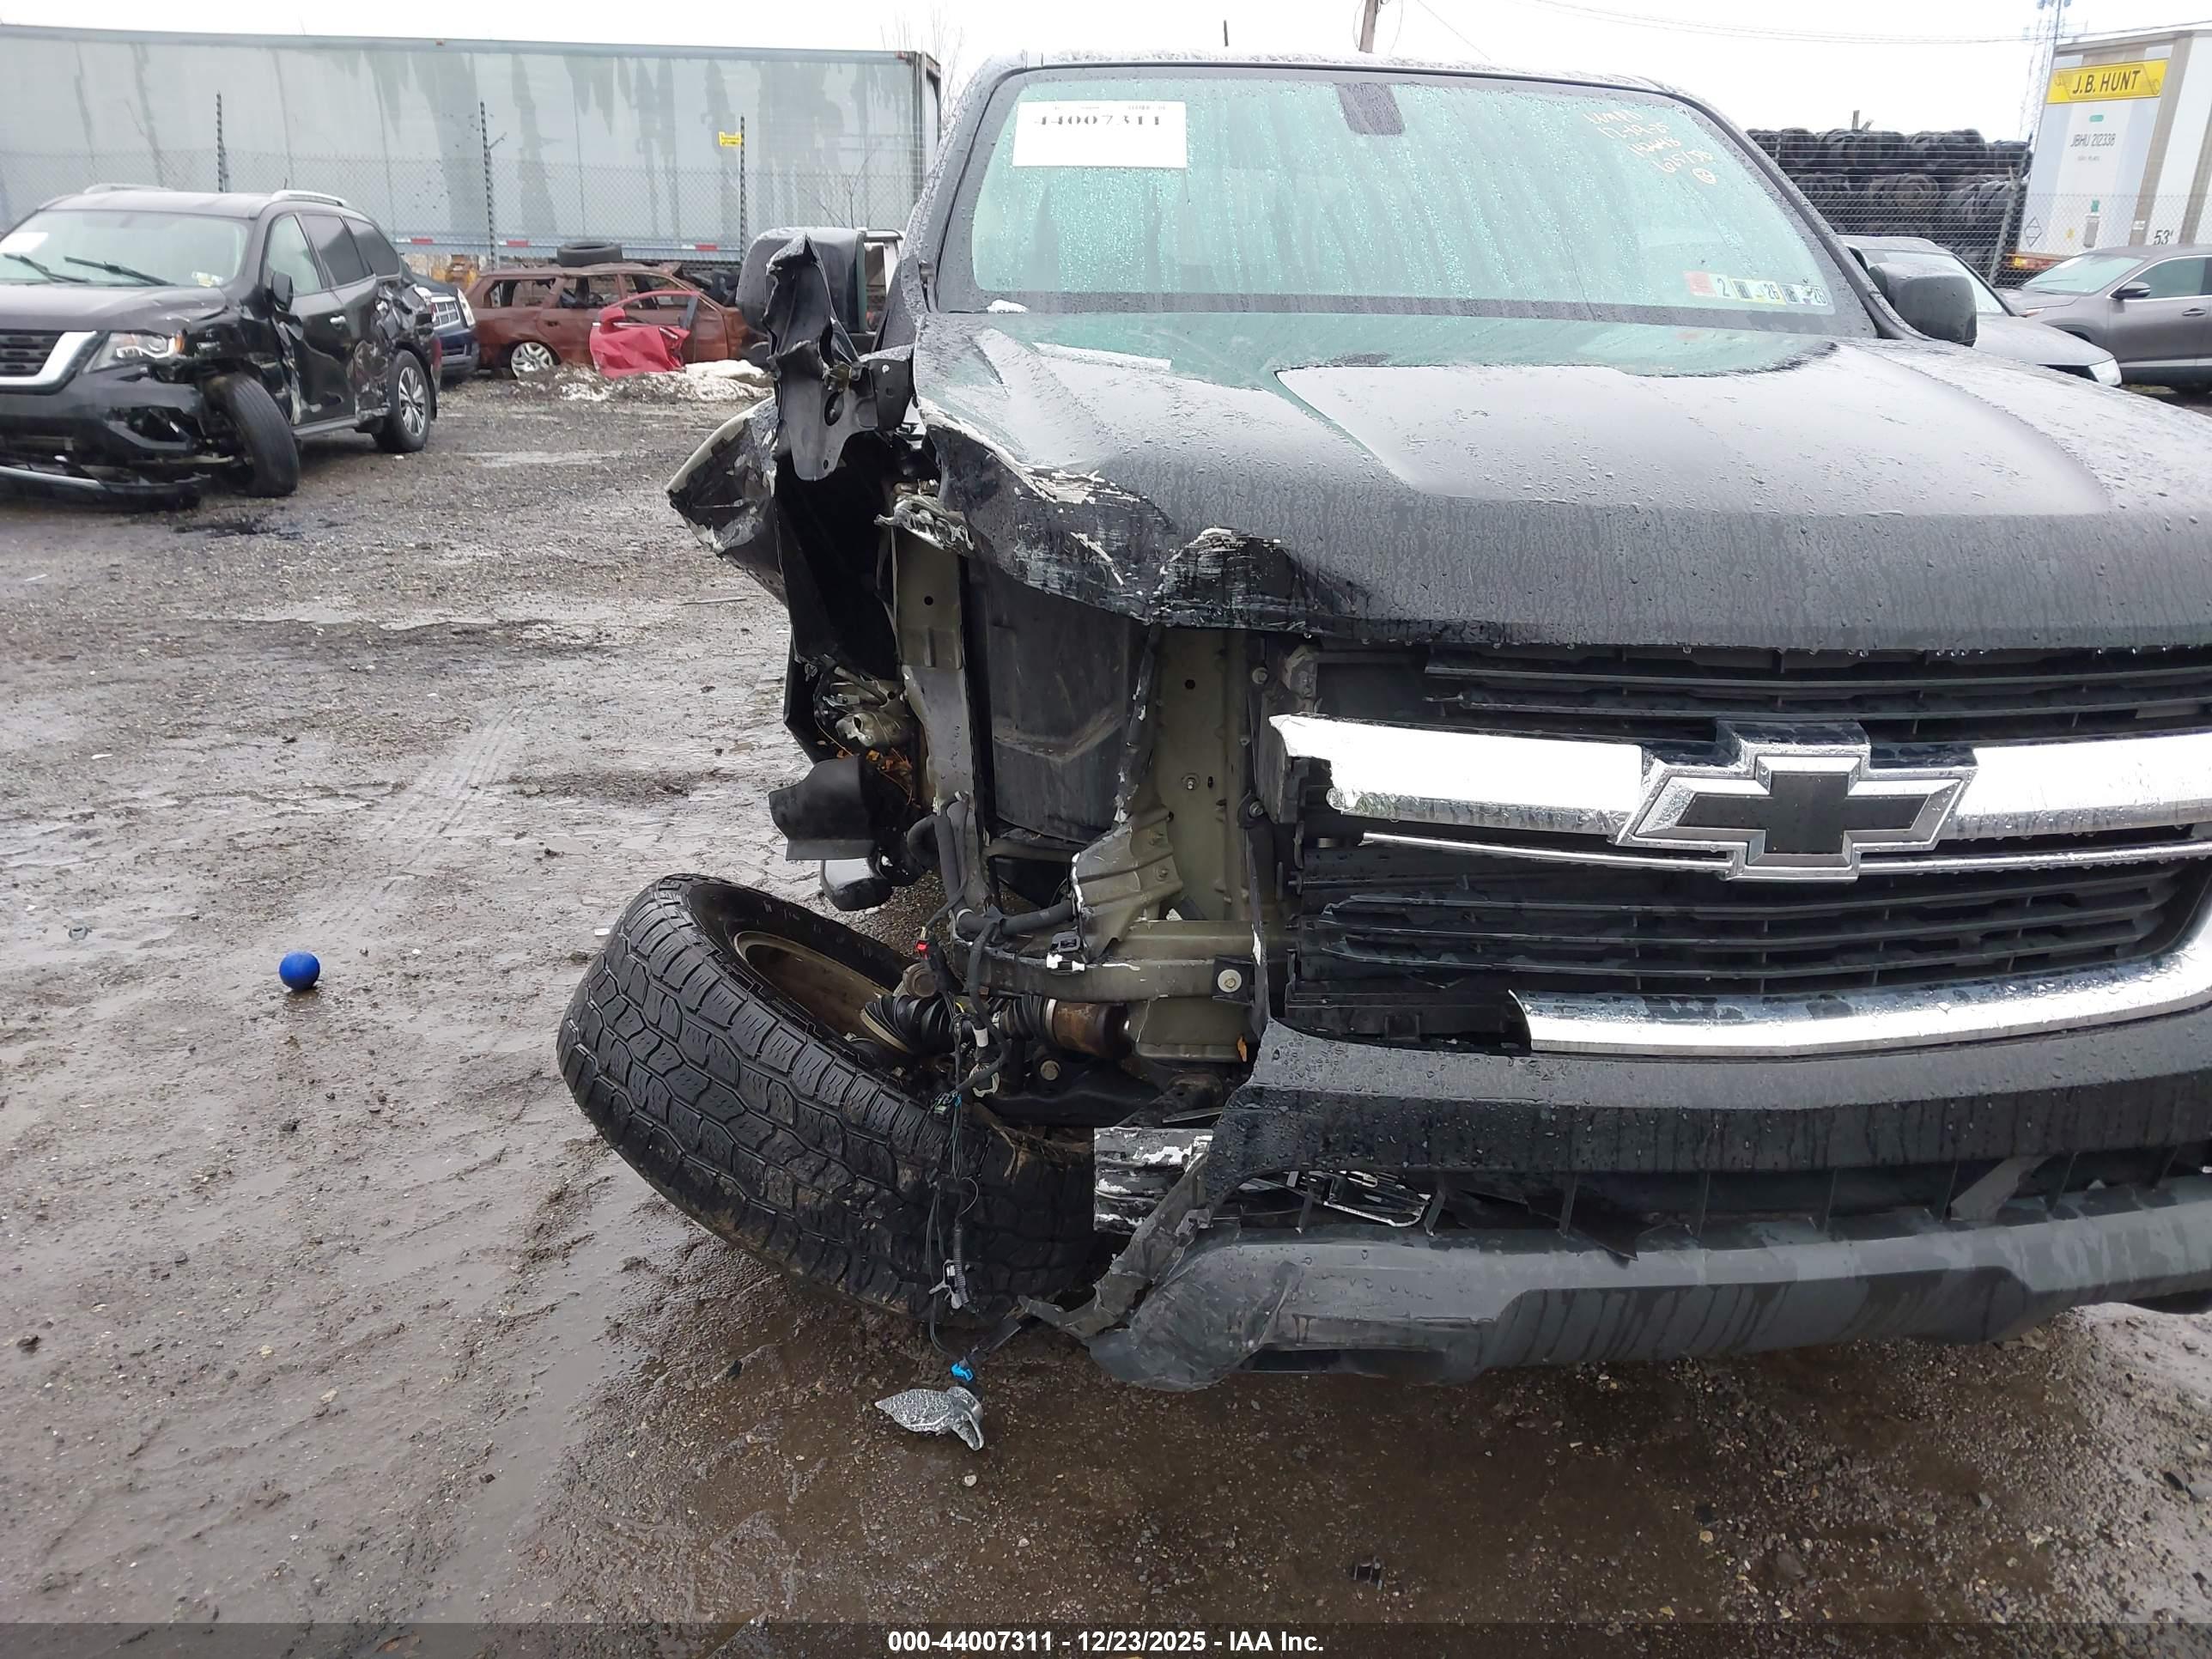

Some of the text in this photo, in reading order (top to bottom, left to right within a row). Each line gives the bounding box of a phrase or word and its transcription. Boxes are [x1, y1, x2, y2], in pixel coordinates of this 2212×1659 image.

[2072, 70, 2141, 94] J.B. HUNT
[1764, 283, 1781, 300] 26
